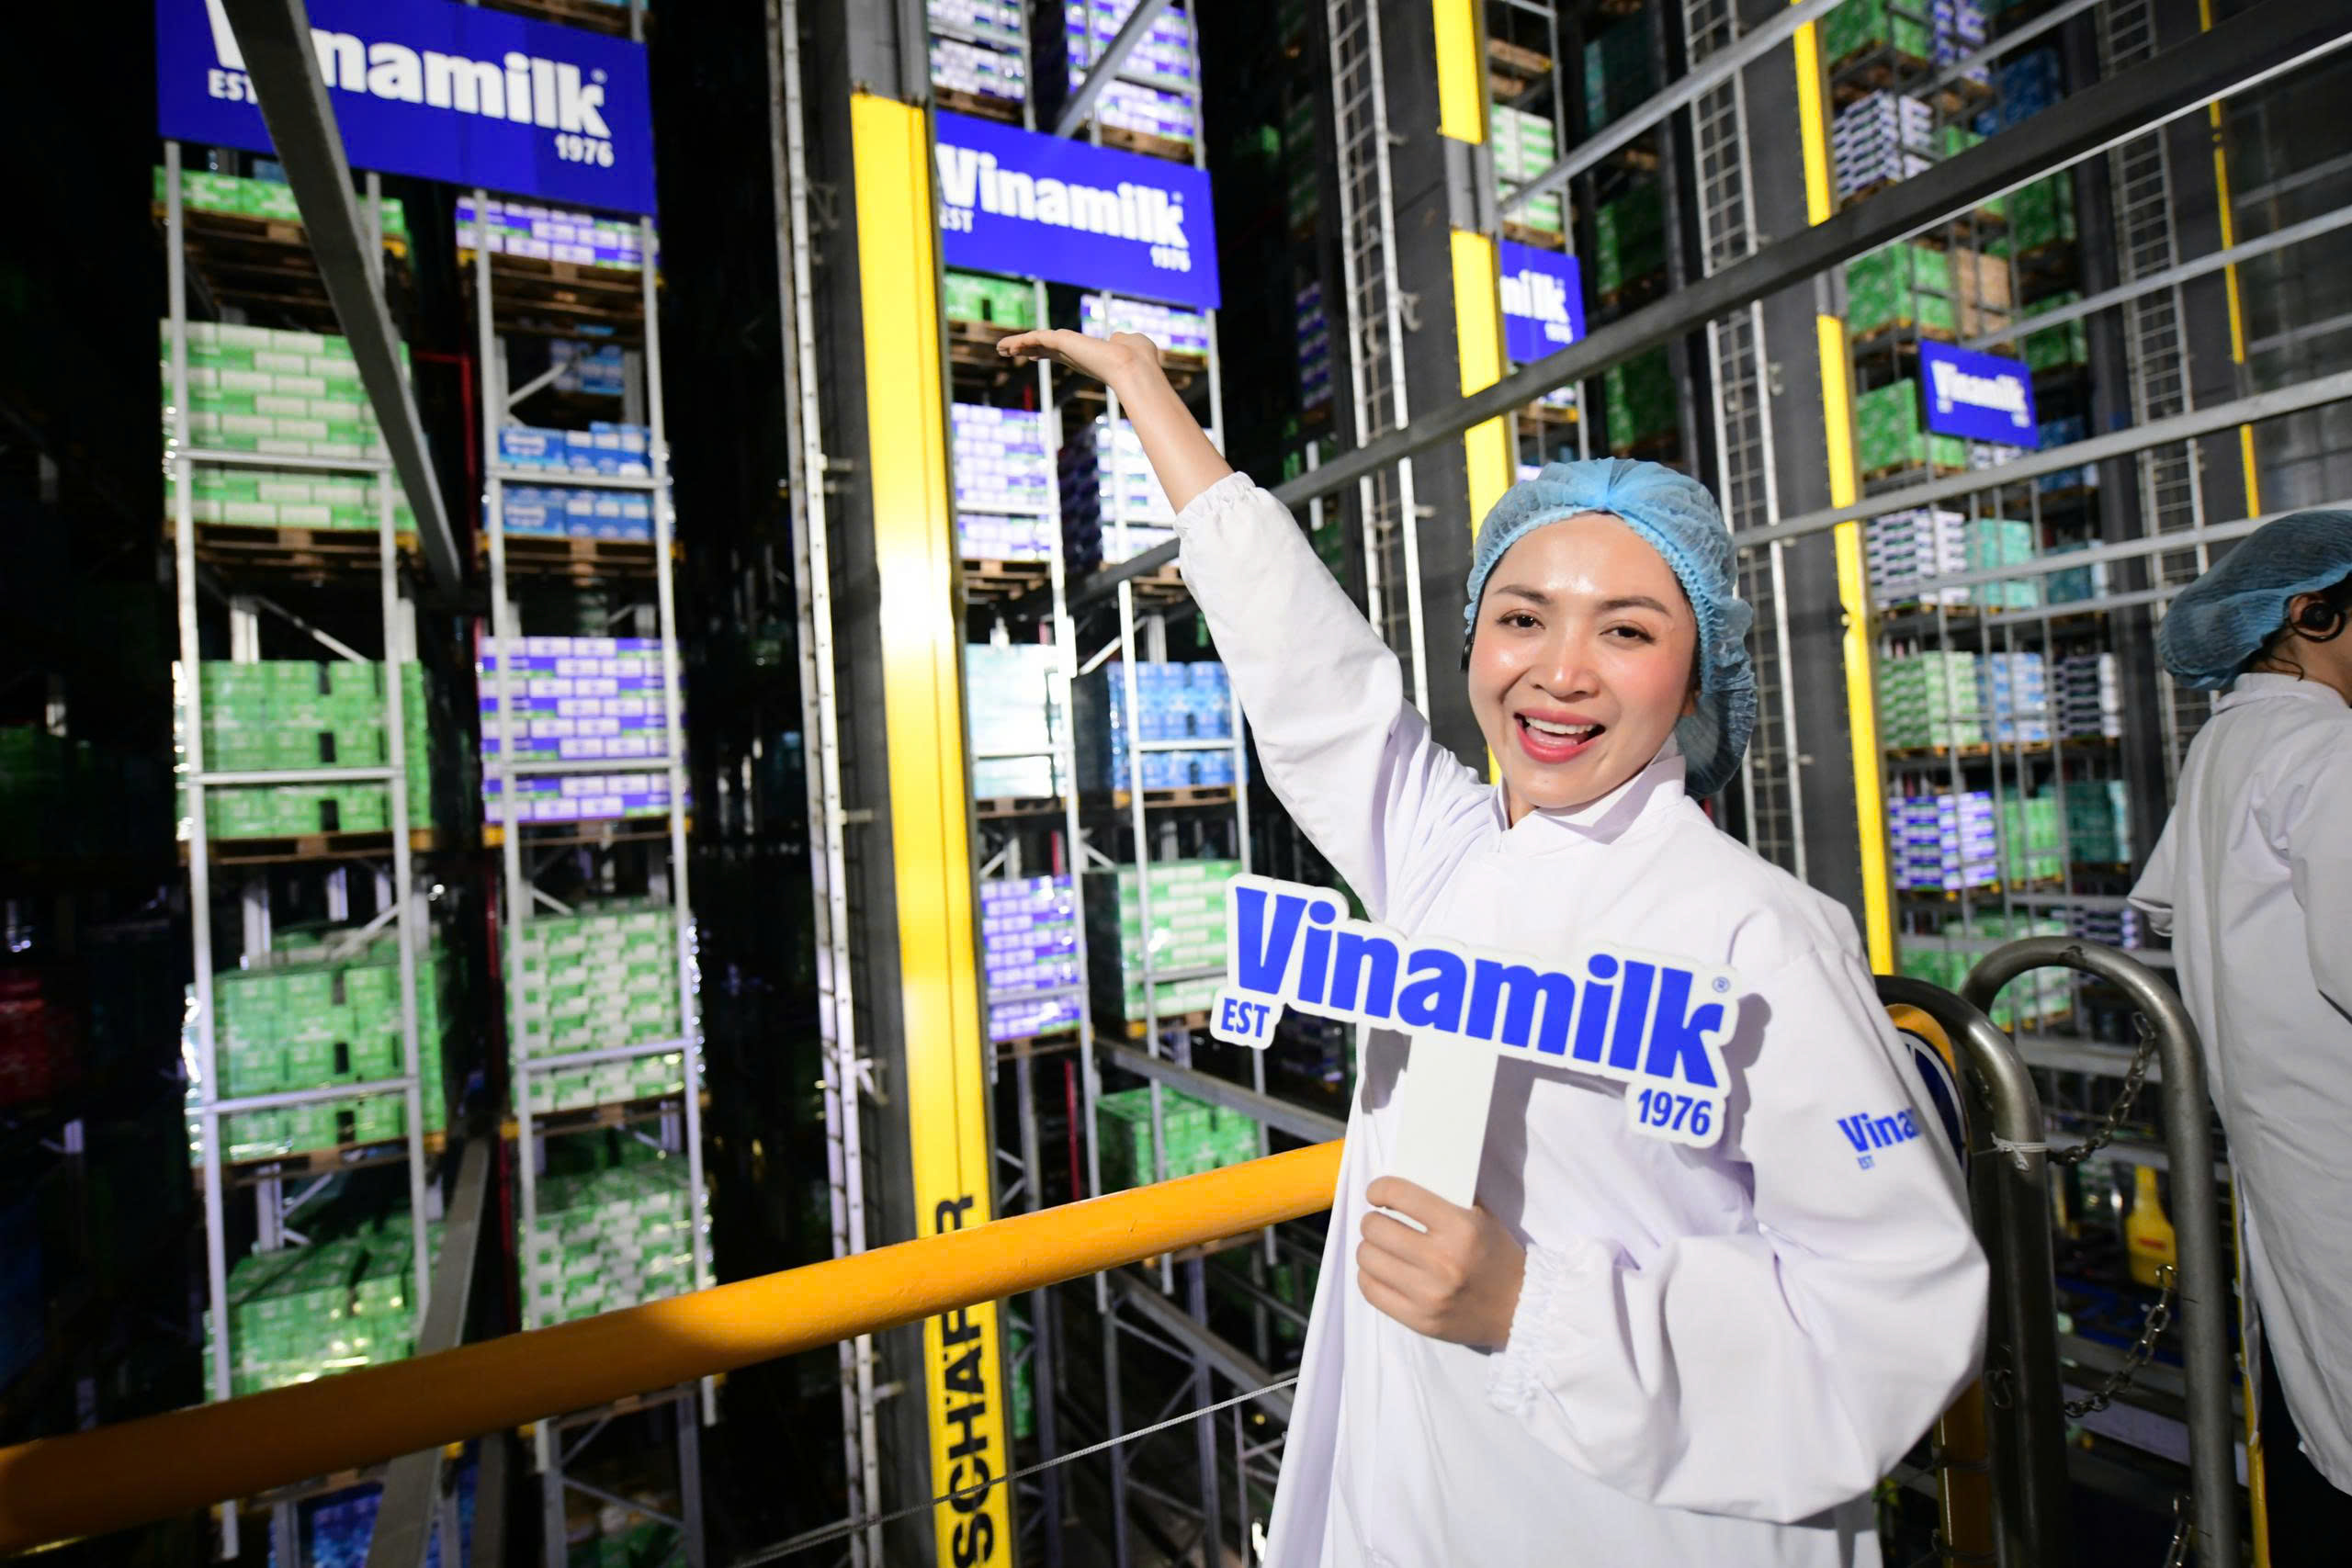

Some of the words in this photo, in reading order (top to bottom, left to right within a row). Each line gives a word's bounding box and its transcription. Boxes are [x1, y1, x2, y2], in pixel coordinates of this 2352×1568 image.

[205, 0, 611, 138] namilk
[556, 132, 614, 168] 1976
[935, 141, 1189, 249] Vinamilk
[1220, 998, 1270, 1038] EST
[1235, 886, 1724, 1089] Vinamilk
[1637, 1089, 1712, 1135] 1976
[935, 1195, 995, 1568] SCHÄFR
